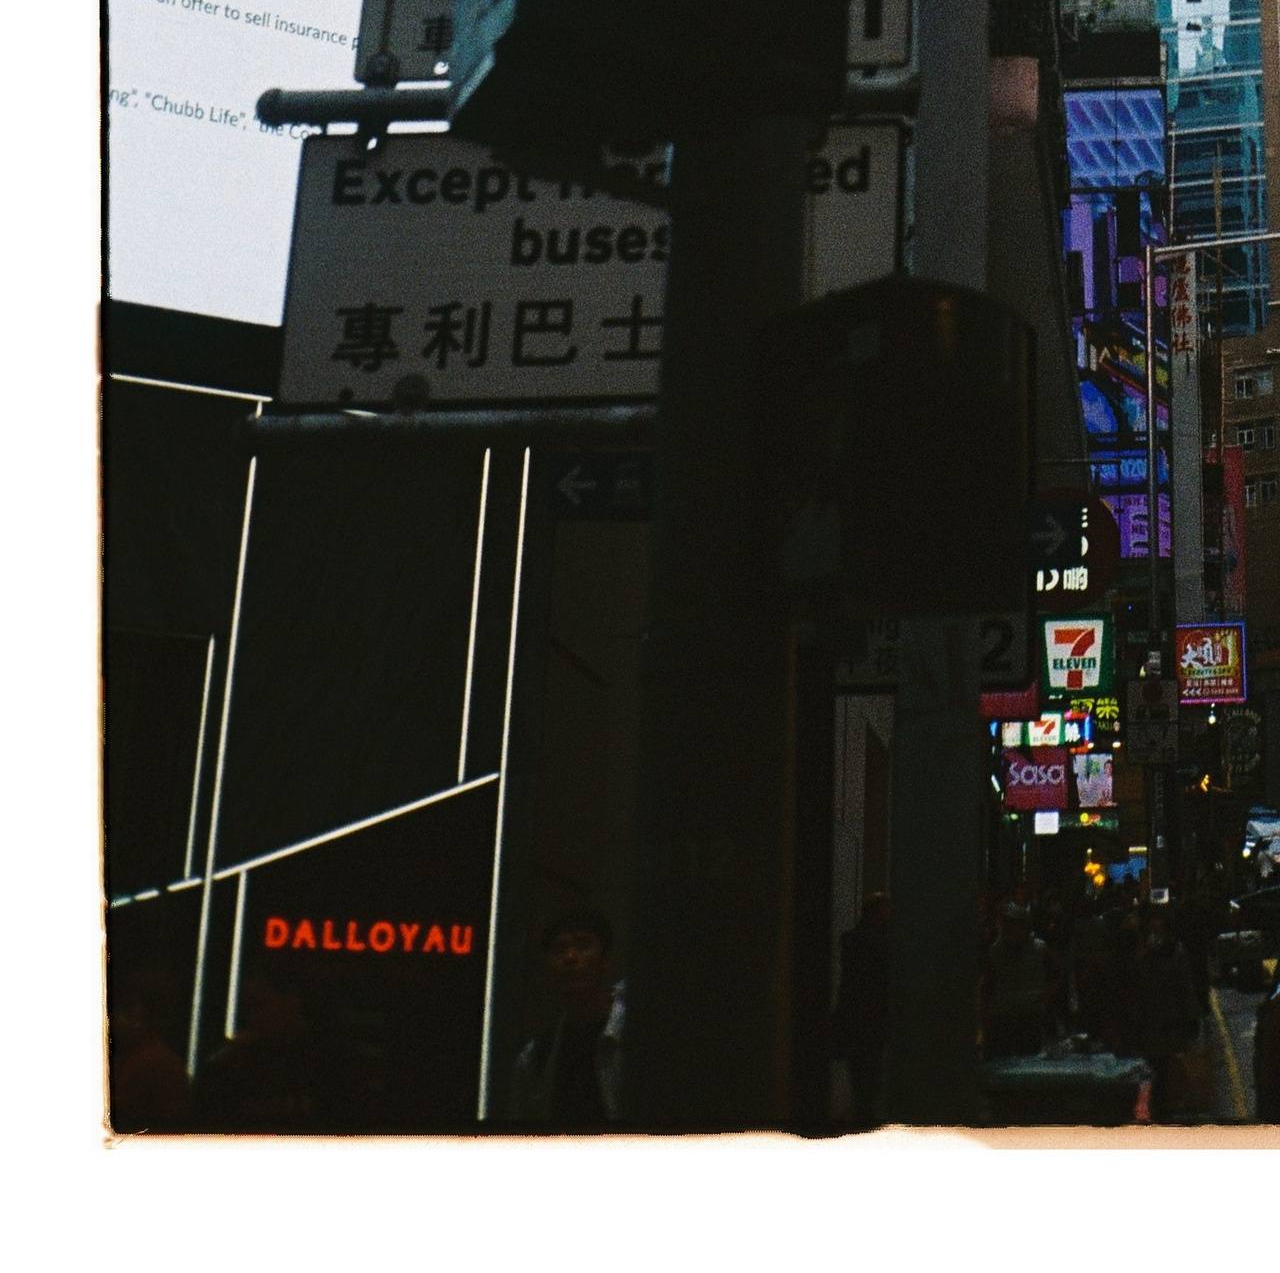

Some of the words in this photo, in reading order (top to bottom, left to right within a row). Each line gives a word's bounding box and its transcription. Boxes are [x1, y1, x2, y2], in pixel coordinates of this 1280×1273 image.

[224, 5, 240, 20] to
[245, 12, 270, 28] sell
[275, 15, 347, 45] insurance
[145, 92, 204, 120] "Chubb
[333, 158, 535, 213] Except
[331, 294, 665, 372] 專利巴士
[1054, 627, 1096, 690] 7
[264, 916, 473, 954] DALLOYAU
